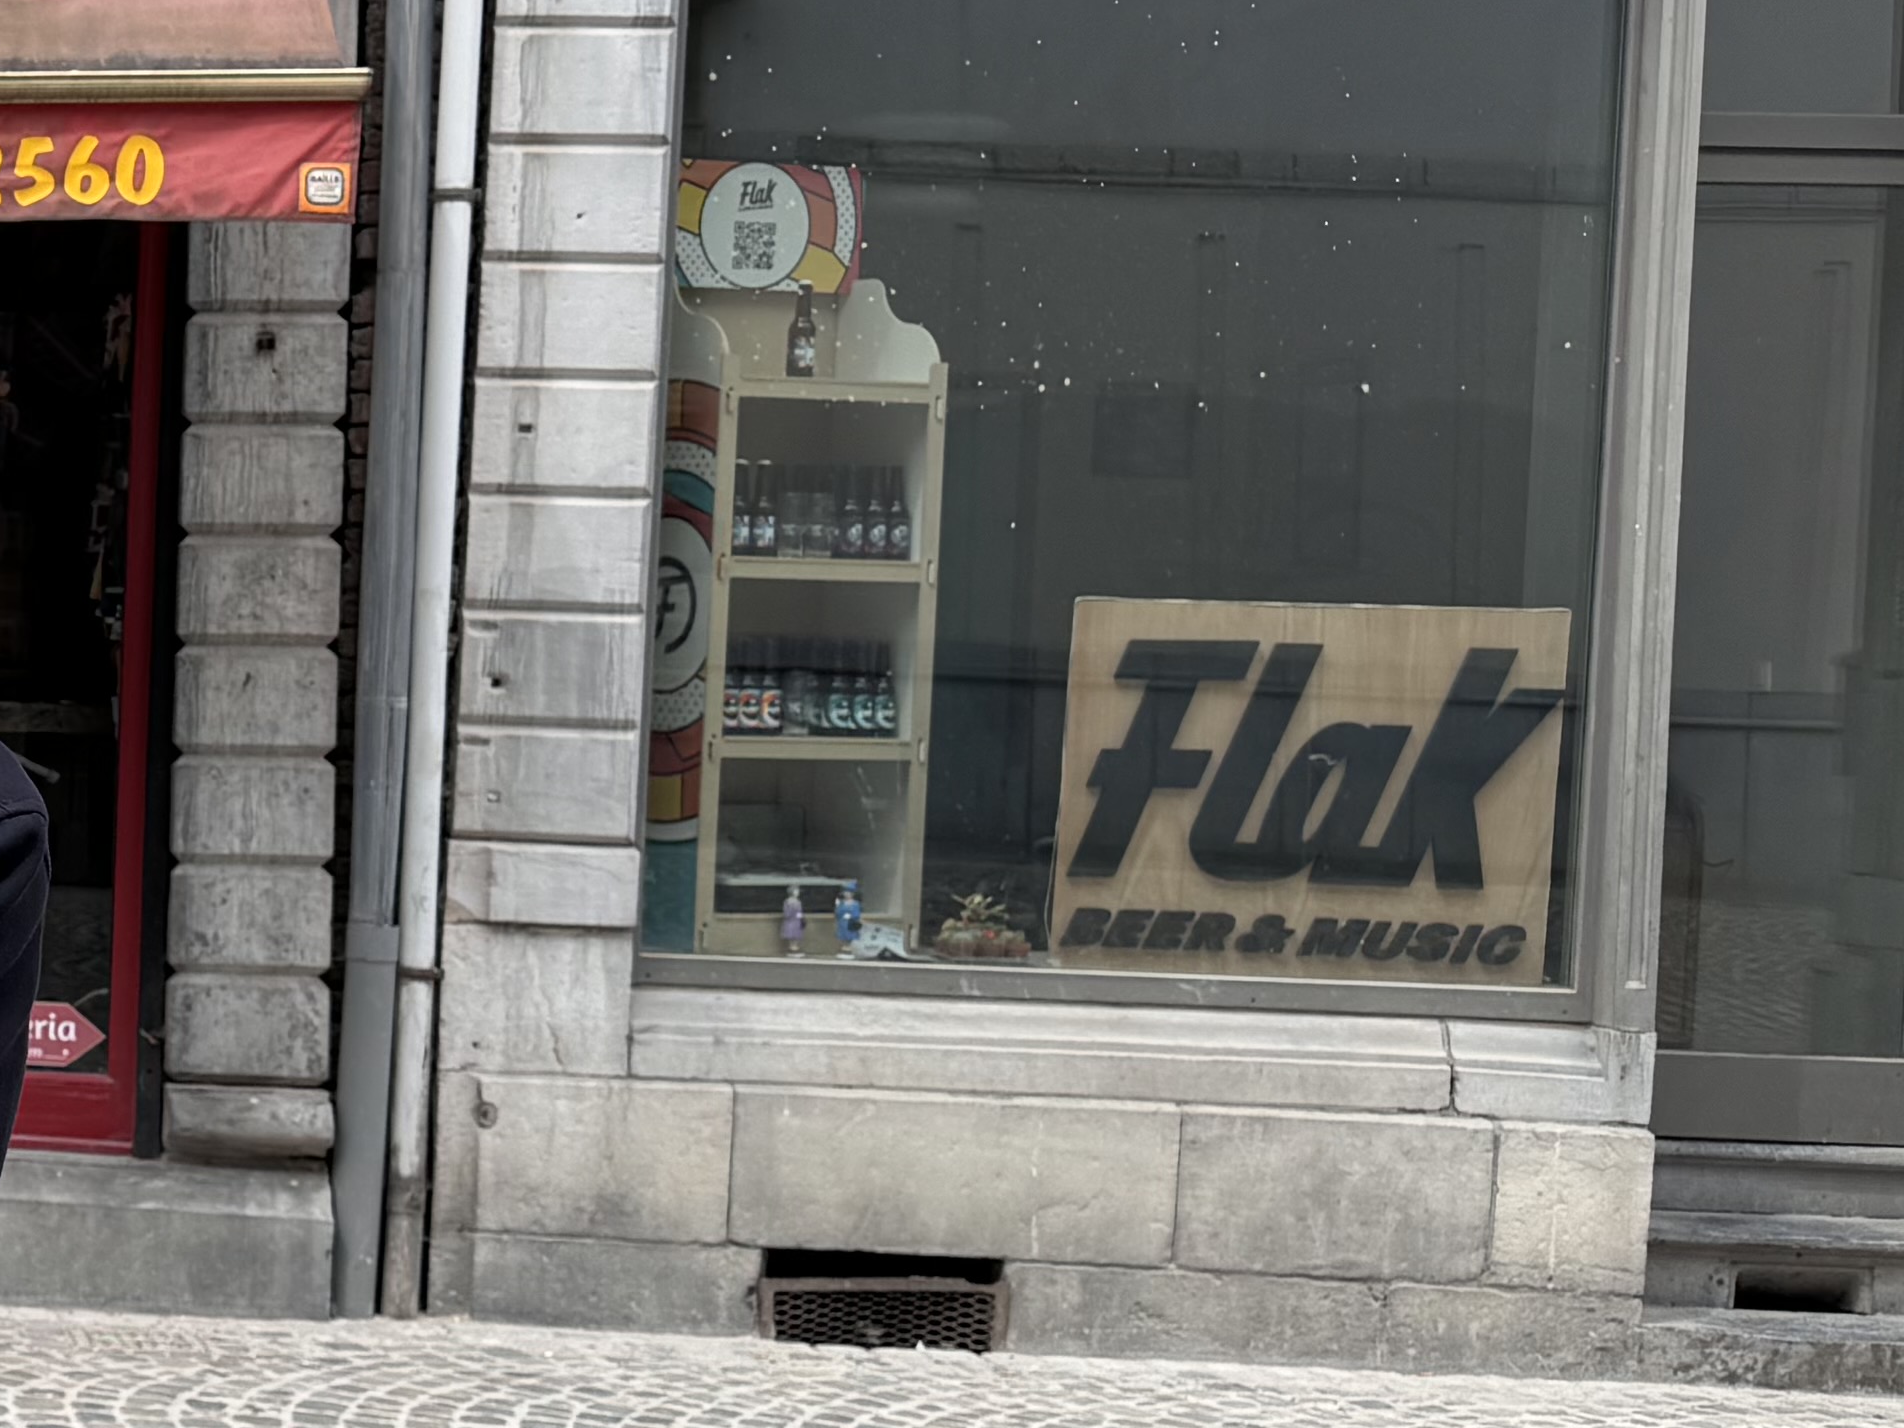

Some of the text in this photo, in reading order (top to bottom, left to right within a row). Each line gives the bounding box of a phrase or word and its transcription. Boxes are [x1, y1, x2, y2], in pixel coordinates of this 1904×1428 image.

[739, 178, 778, 206] Flak
[1066, 638, 1567, 891] Flak
[1059, 907, 1527, 966] BEER & MUSIC
